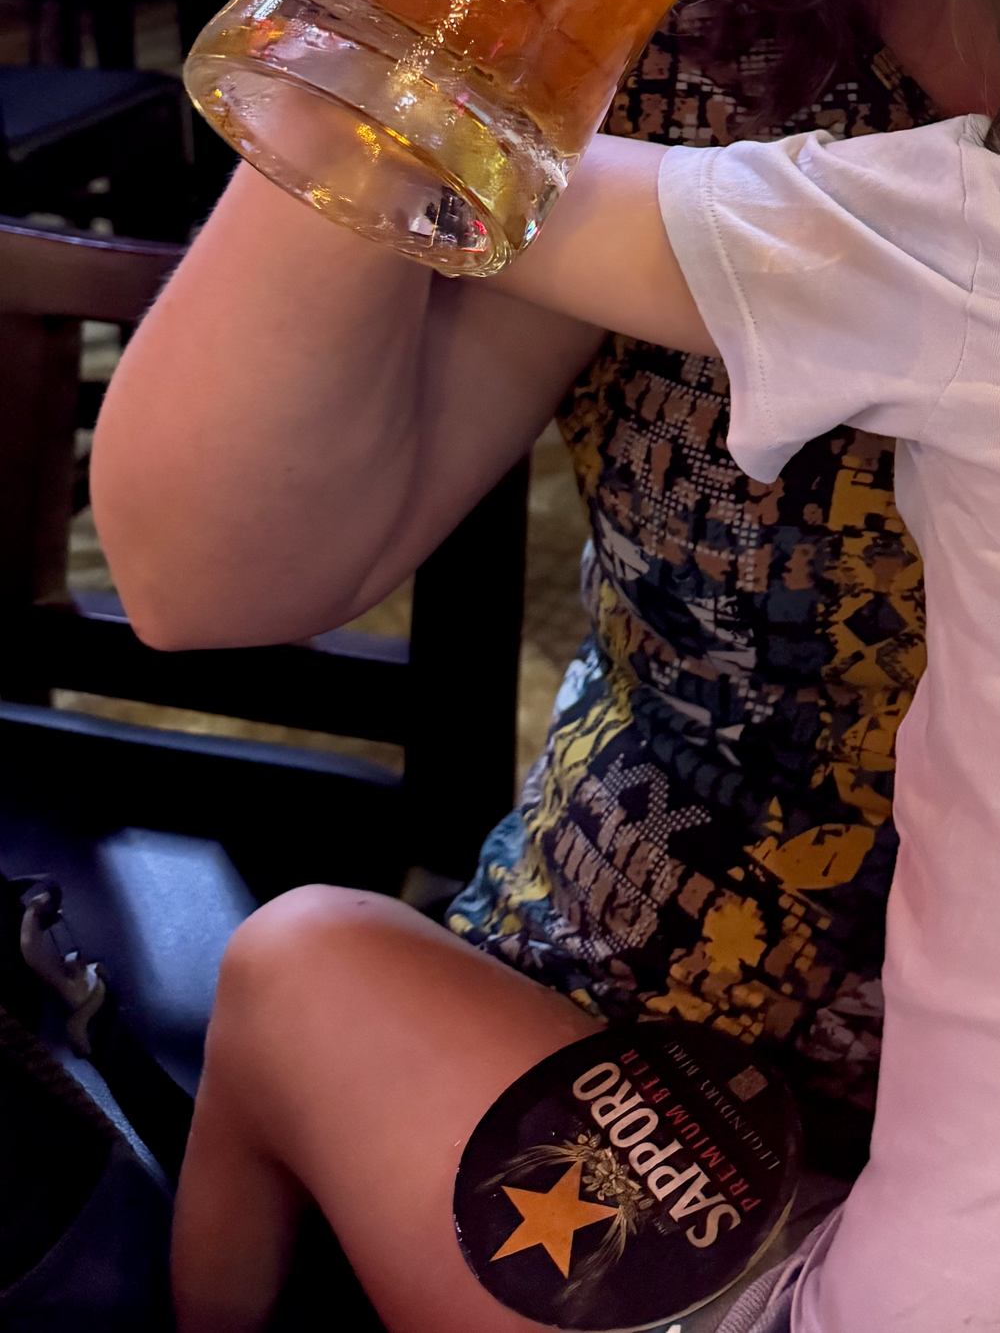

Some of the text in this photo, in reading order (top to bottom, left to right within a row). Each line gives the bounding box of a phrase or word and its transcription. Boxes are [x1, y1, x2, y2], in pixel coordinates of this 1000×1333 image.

[572, 1061, 741, 1249] SAPPORO
[619, 1048, 762, 1213] PREMIUM BEER
